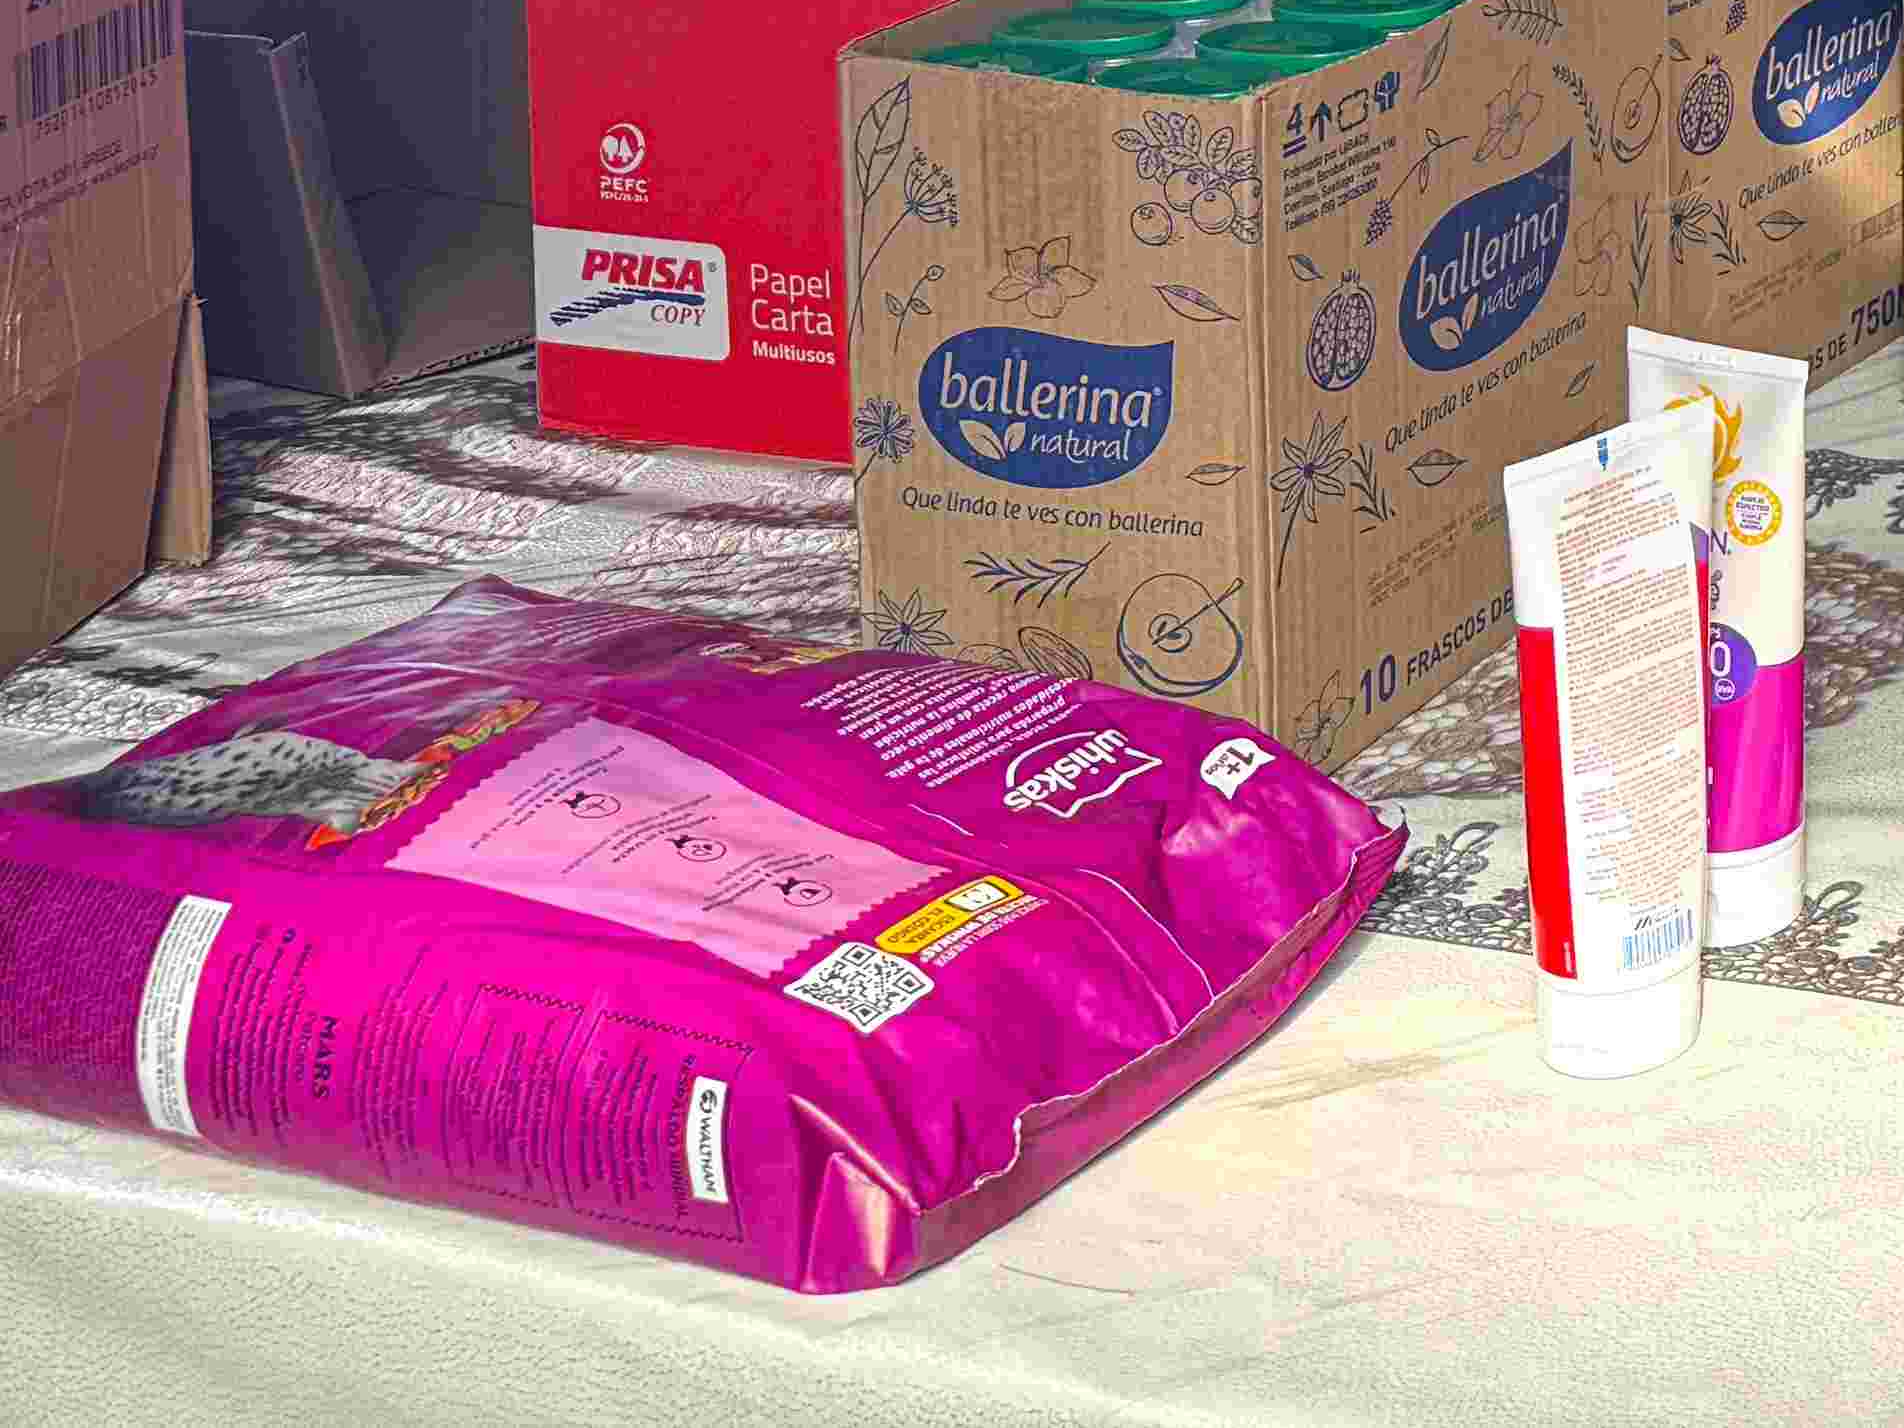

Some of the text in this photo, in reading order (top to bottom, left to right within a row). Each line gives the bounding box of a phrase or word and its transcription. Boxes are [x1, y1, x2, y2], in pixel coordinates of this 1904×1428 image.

[1765, 10, 1894, 102] ballerina
[1819, 55, 1881, 105] natural
[600, 175, 648, 194] PEFC
[1739, 177, 1764, 211] Que
[1767, 159, 1800, 195] linda
[1817, 144, 1837, 171] ves
[1839, 131, 1863, 159] con
[1863, 110, 1904, 148] baller
[581, 249, 705, 293] PRISA
[751, 263, 831, 304] Papel
[1416, 194, 1562, 322] ballerina
[1479, 255, 1547, 318] natural
[650, 304, 706, 327] COPY
[751, 299, 834, 337] Carta
[752, 339, 837, 366] Multiusos
[941, 352, 1152, 428] ballerina
[1386, 416, 1418, 452] Que
[1419, 393, 1457, 432] linda
[1477, 372, 1500, 397] ves
[1503, 353, 1528, 383] con
[1528, 311, 1587, 364] ballerina
[1030, 429, 1131, 464] natural
[902, 486, 942, 513] Que
[948, 490, 997, 519] linda
[1027, 503, 1060, 525] ves
[1064, 506, 1101, 530] con
[1109, 505, 1204, 537] ballerina
[1360, 653, 1397, 716] 10
[1407, 607, 1487, 687] FRASCOS
[1004, 728, 1128, 810] whiskas
[312, 1015, 338, 1099] MARS
